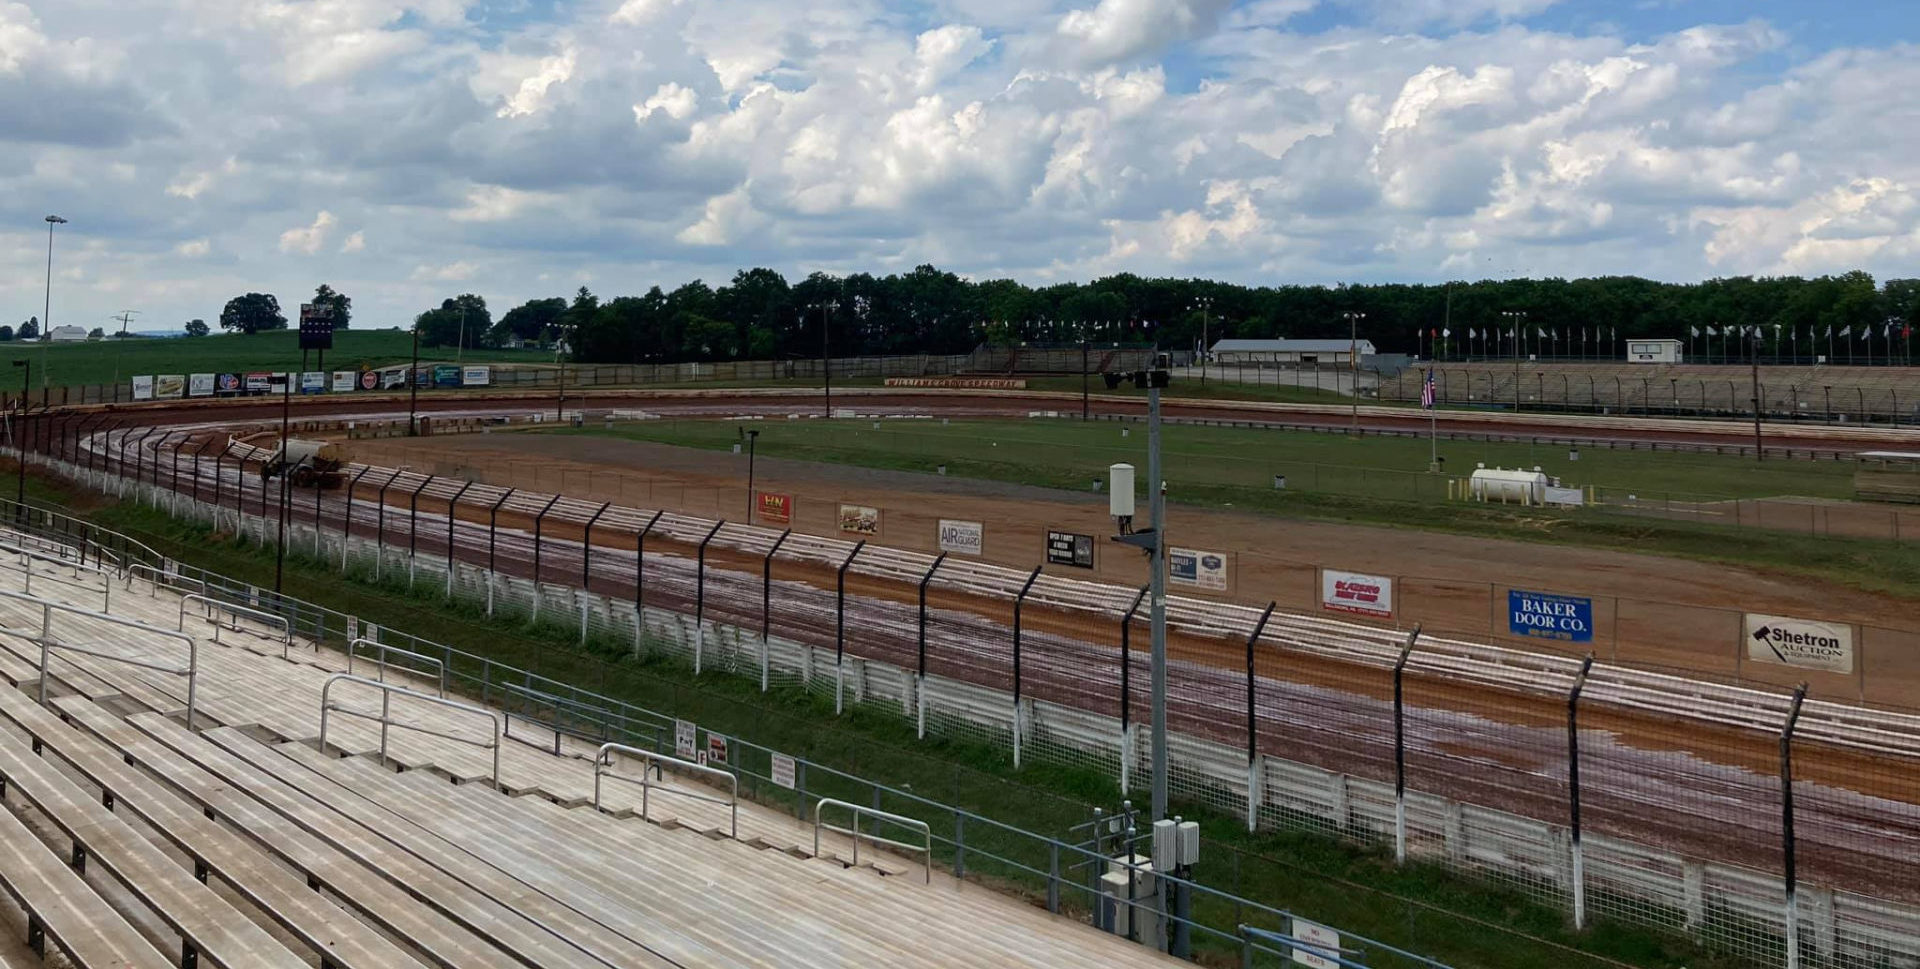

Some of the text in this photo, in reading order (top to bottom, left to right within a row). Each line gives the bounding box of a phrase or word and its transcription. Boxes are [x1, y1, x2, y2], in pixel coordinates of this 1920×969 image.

[888, 380, 1017, 389] WILLIAMS GROVE SPEEDWAY
[941, 526, 958, 544] AIR
[959, 528, 979, 537] NATIONAL
[958, 535, 979, 546] GUARD
[1522, 599, 1576, 617] BAKER
[1515, 611, 1587, 632] DOOR CO.
[1772, 628, 1839, 648] Shetron
[1780, 643, 1843, 656] AUCTION
[1790, 652, 1830, 661] EQUIPMENT
